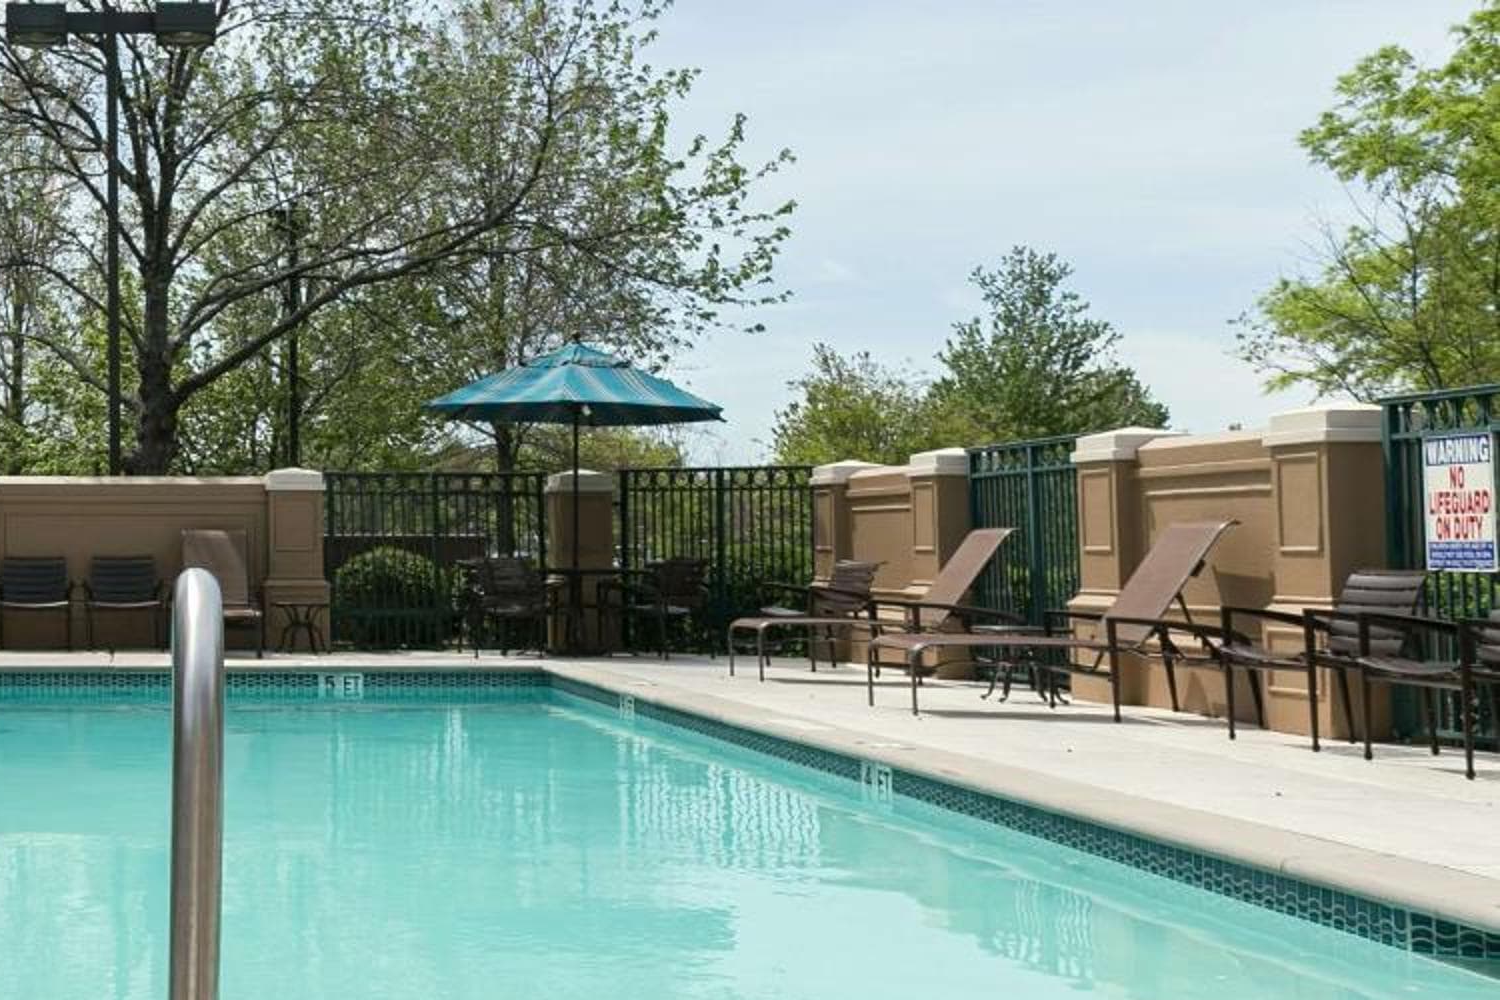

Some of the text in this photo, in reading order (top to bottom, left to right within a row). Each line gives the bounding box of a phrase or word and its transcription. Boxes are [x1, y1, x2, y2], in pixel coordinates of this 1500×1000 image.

[1426, 437, 1490, 465] WARNING
[1449, 466, 1465, 489] NO
[1429, 490, 1490, 515] LIFEGUARD
[1436, 515, 1483, 539] ON DUTY
